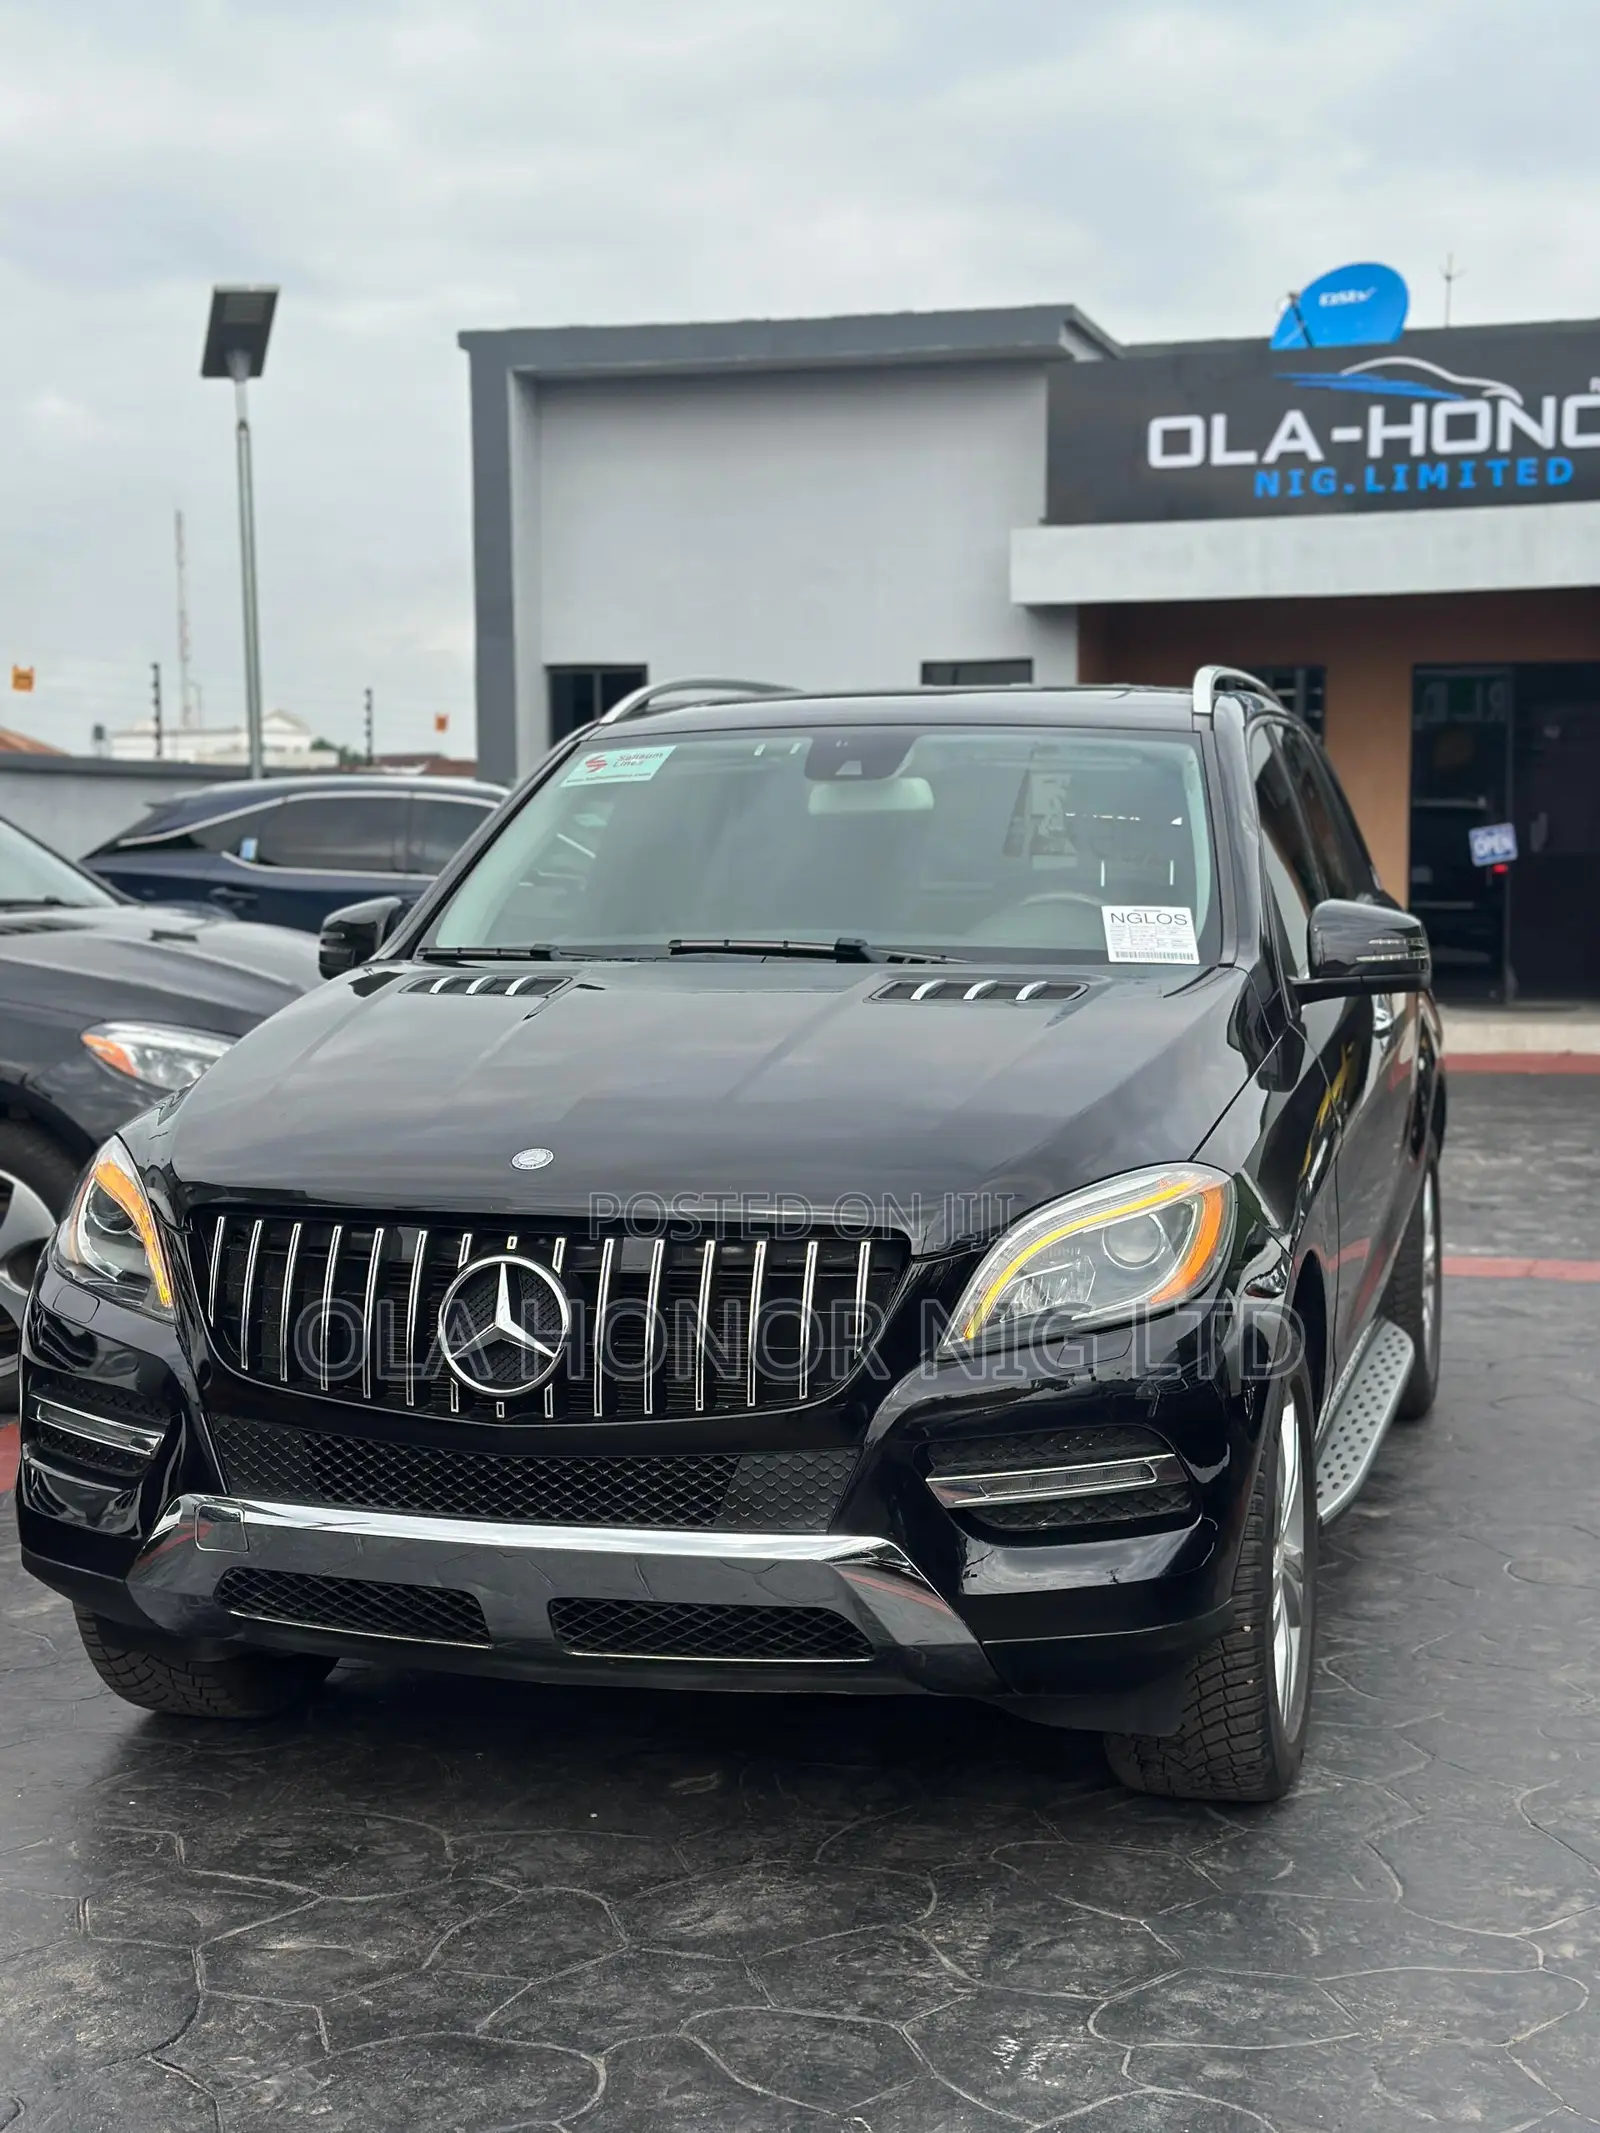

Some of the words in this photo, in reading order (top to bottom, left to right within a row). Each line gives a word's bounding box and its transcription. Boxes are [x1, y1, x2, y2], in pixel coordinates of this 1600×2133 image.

[1253, 456, 1575, 498] NIG.LIMITED
[1474, 834, 1513, 856] OPEN
[1110, 912, 1188, 925] NGLOS
